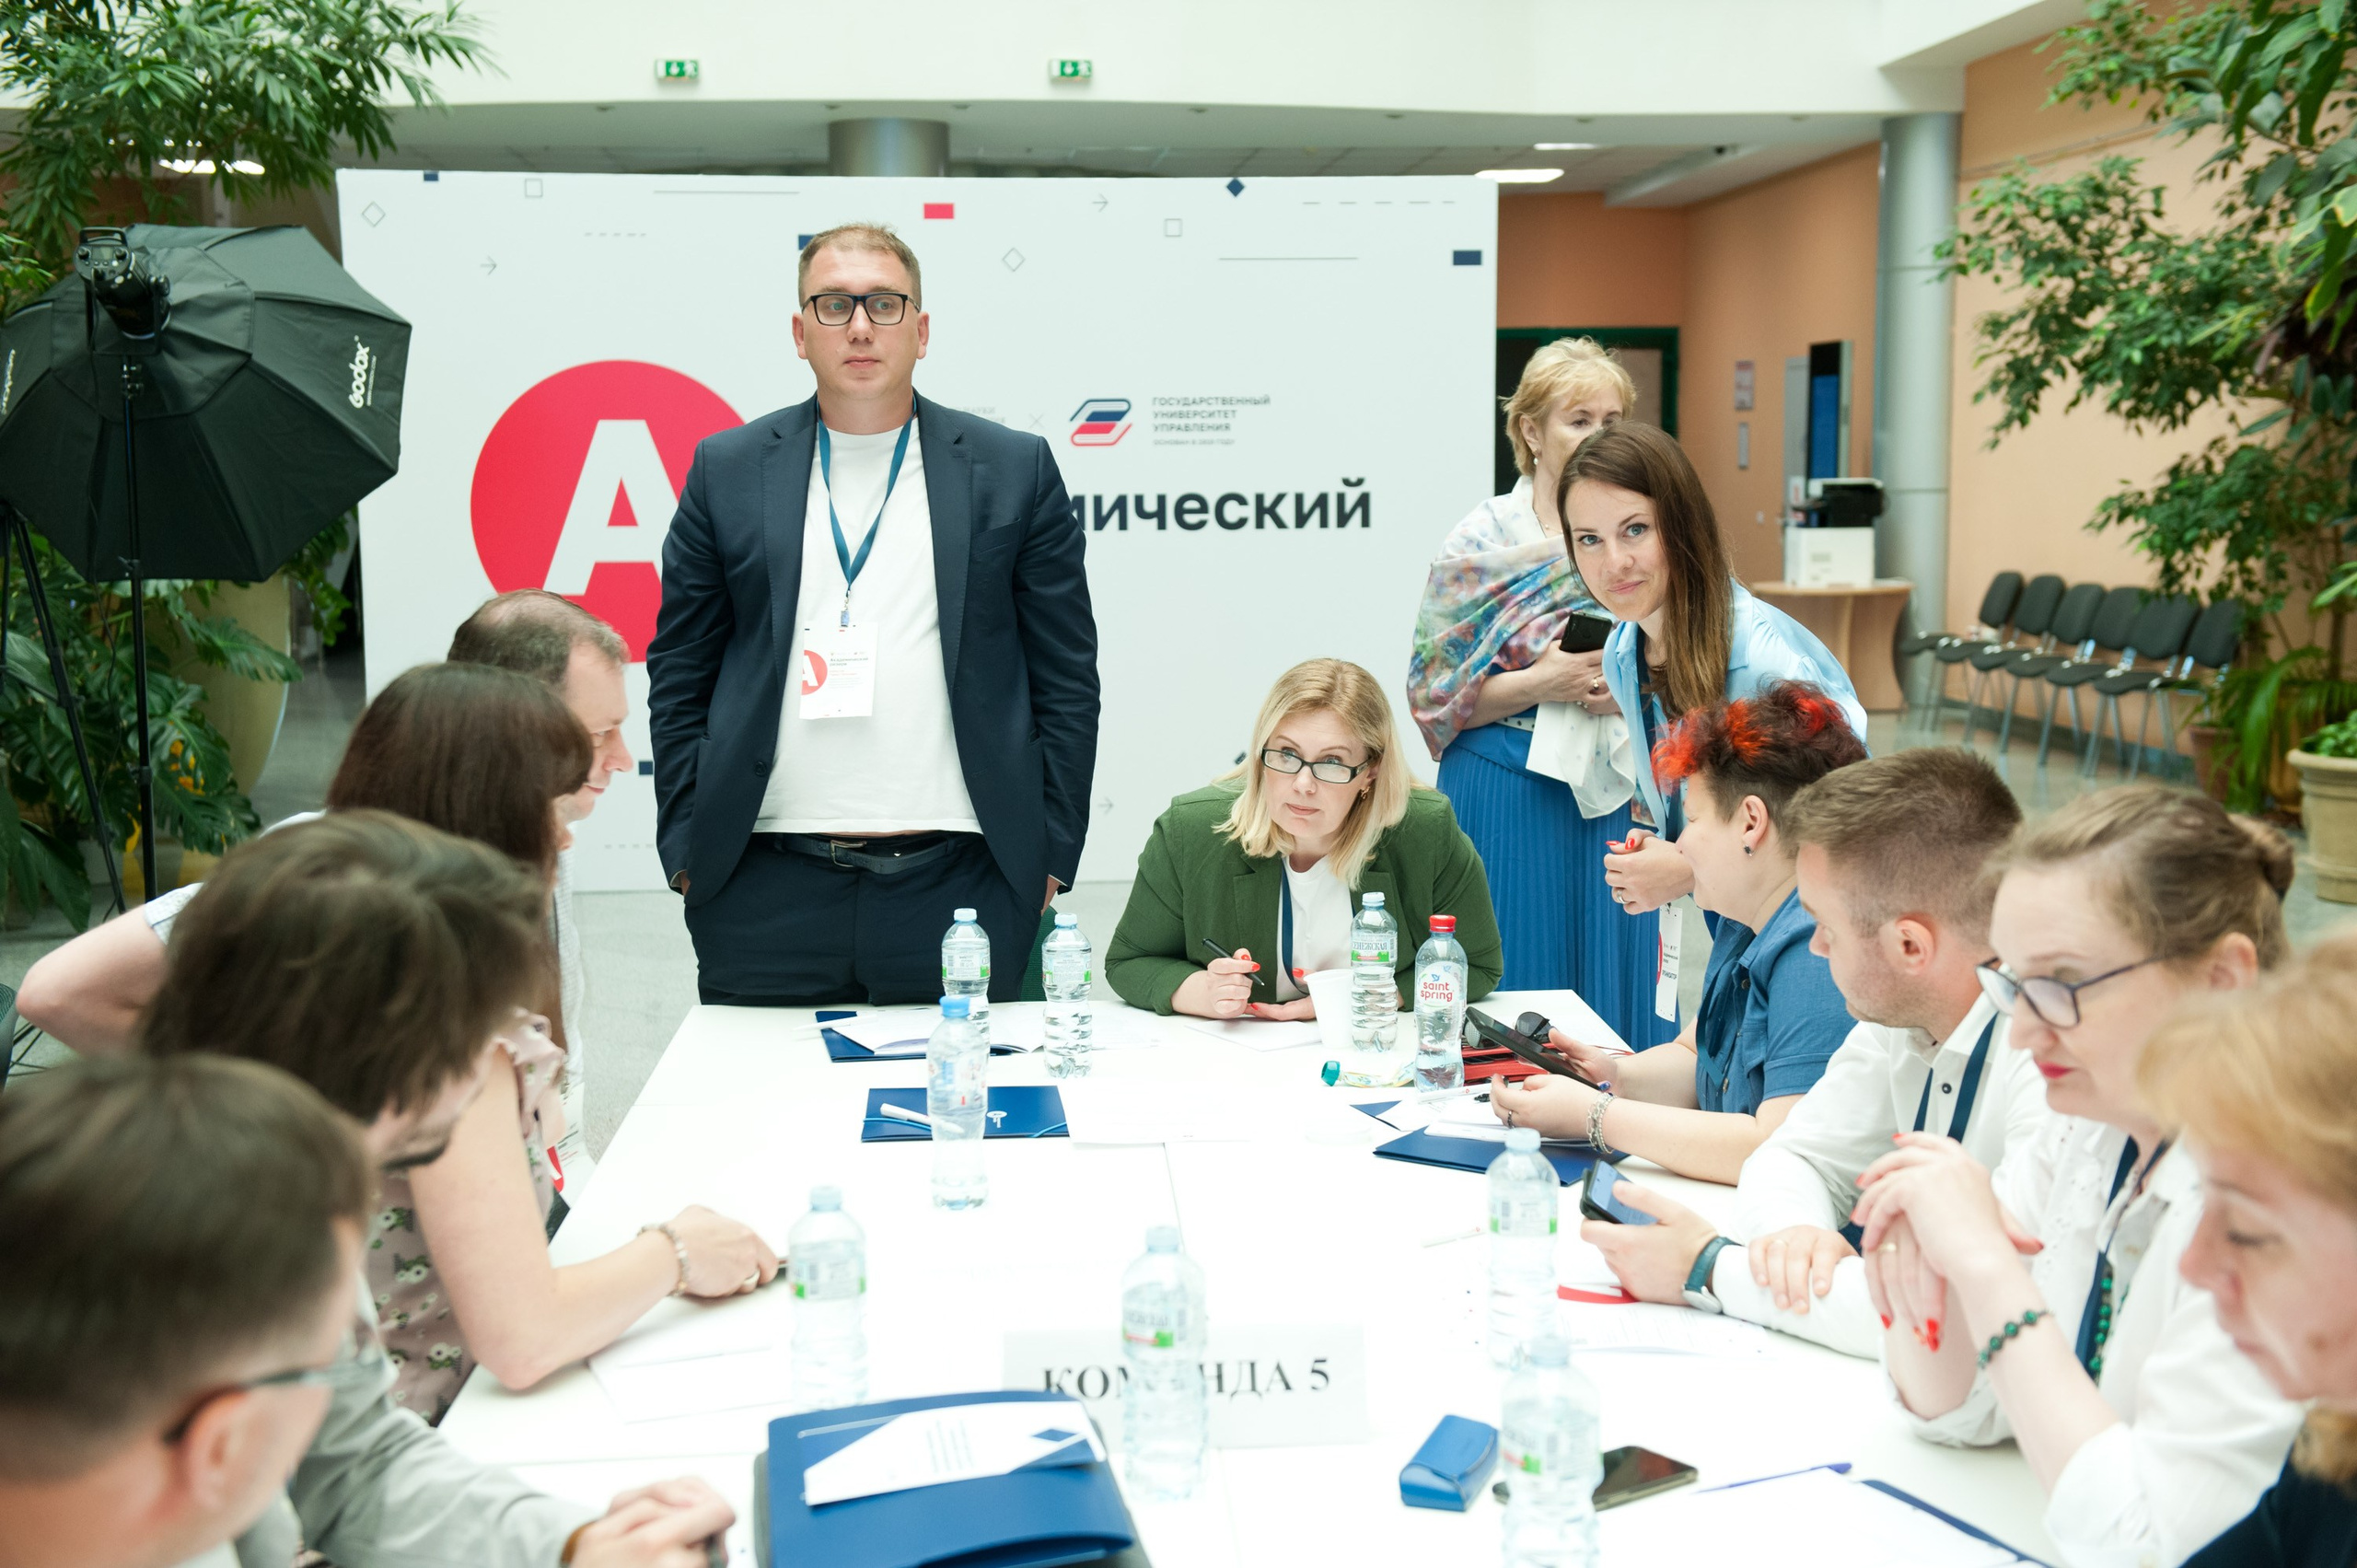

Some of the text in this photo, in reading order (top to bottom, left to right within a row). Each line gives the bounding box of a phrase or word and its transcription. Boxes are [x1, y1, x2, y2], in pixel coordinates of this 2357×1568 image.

[349, 342, 370, 409] Godox
[1153, 394, 1271, 407] ГОСУДАРСТВЕННЫЙ
[1153, 409, 1237, 419] УНИВЕРСИТЕТ
[1153, 423, 1231, 432] УПРАВЛЕНИЯ
[1422, 981, 1450, 991] saint
[1420, 990, 1453, 1003] spring
[1043, 1357, 1329, 1401] КОНДА 5
